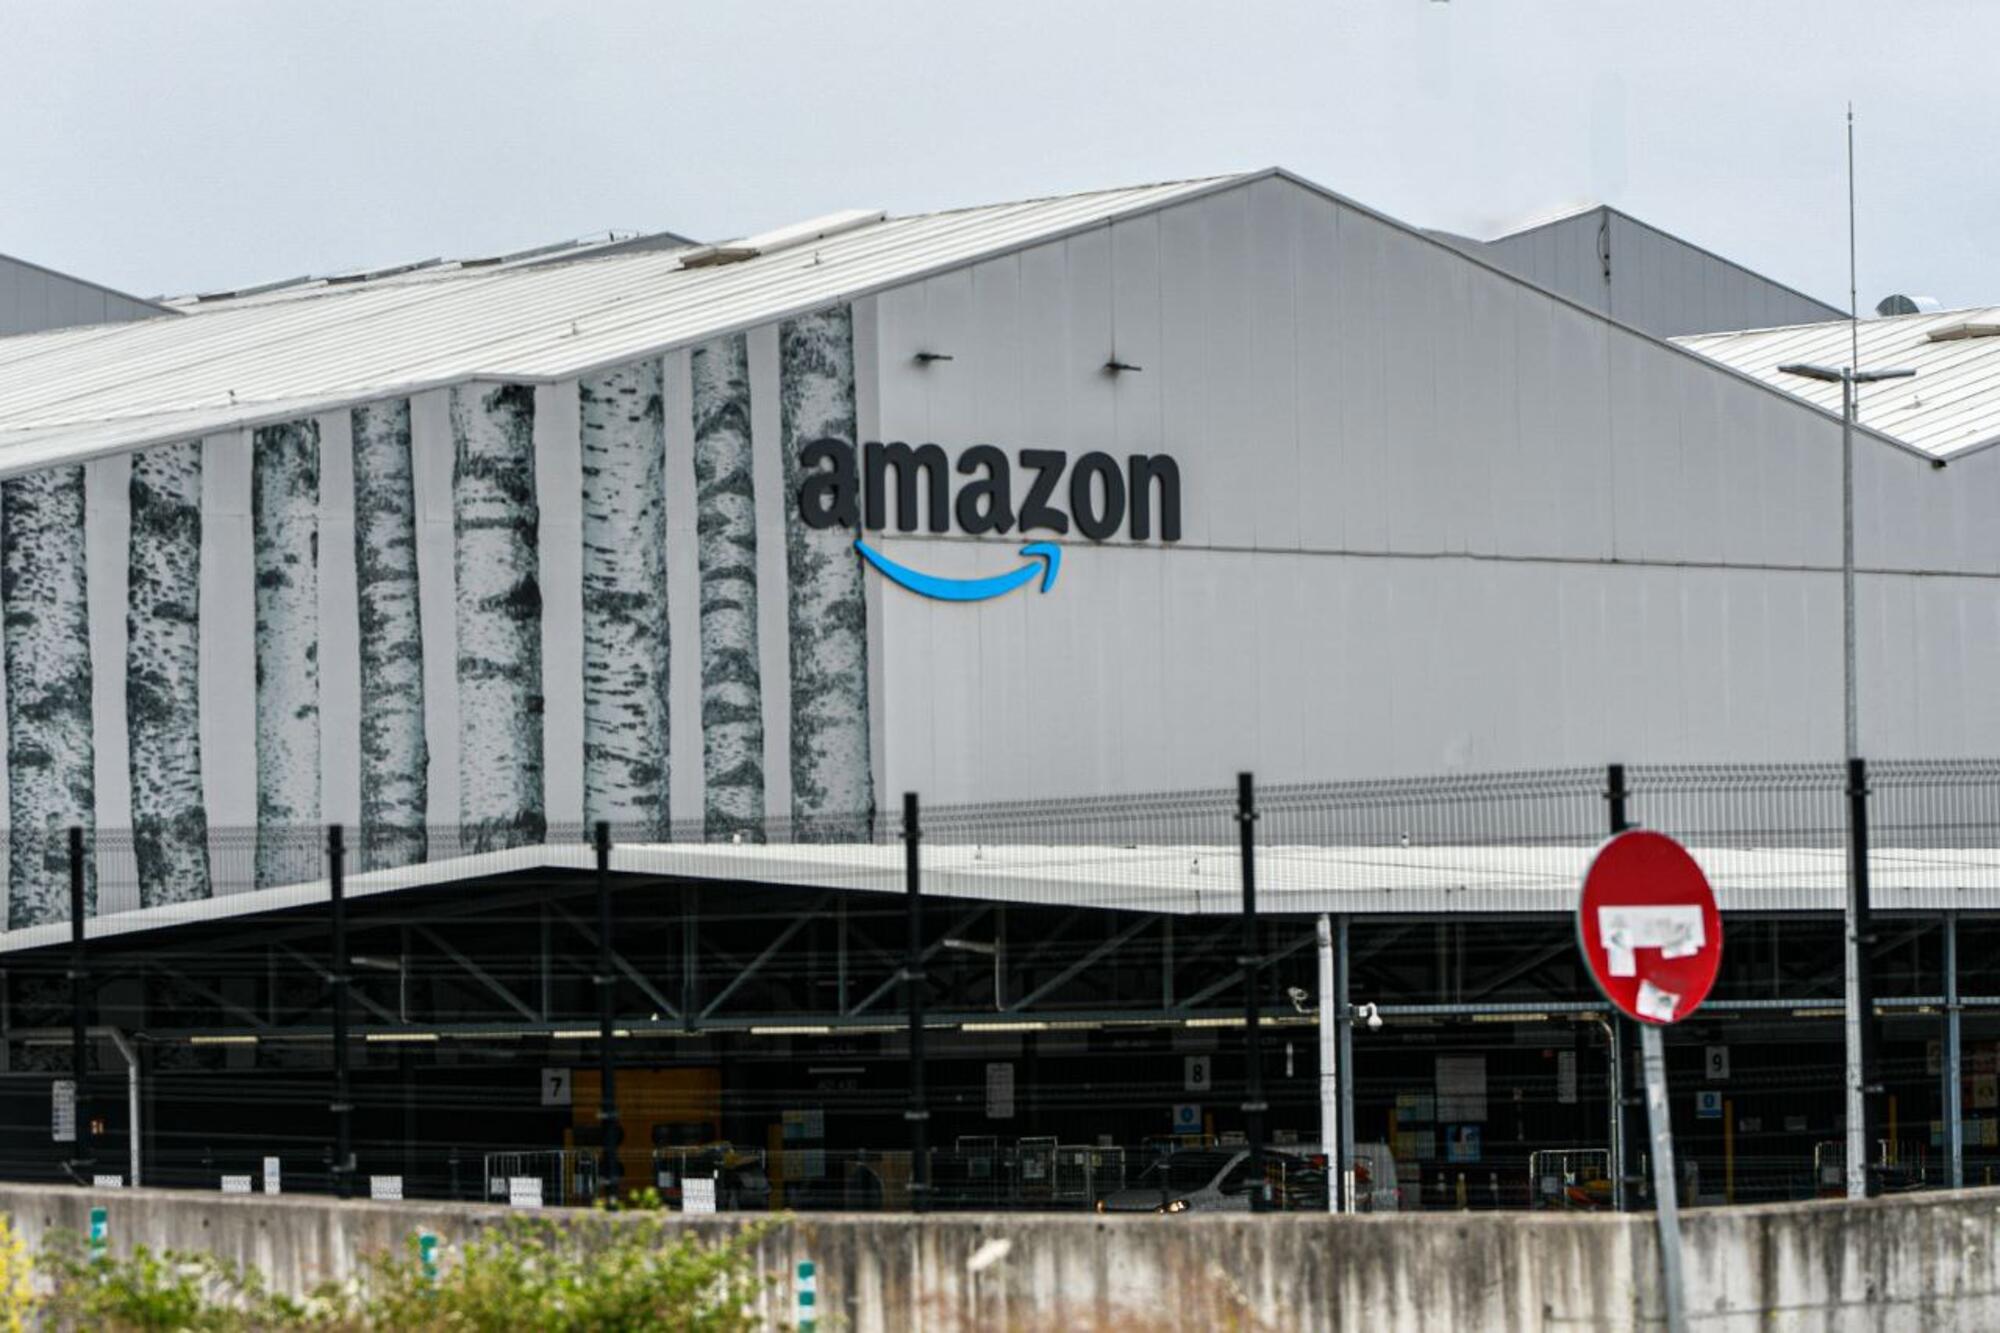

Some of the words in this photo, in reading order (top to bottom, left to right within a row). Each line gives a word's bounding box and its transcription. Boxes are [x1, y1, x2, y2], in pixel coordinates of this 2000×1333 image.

[799, 437, 1182, 542] amazon
[1712, 1054, 1722, 1072] 9
[1192, 1065, 1203, 1083] 8
[550, 1077, 563, 1098] 7
